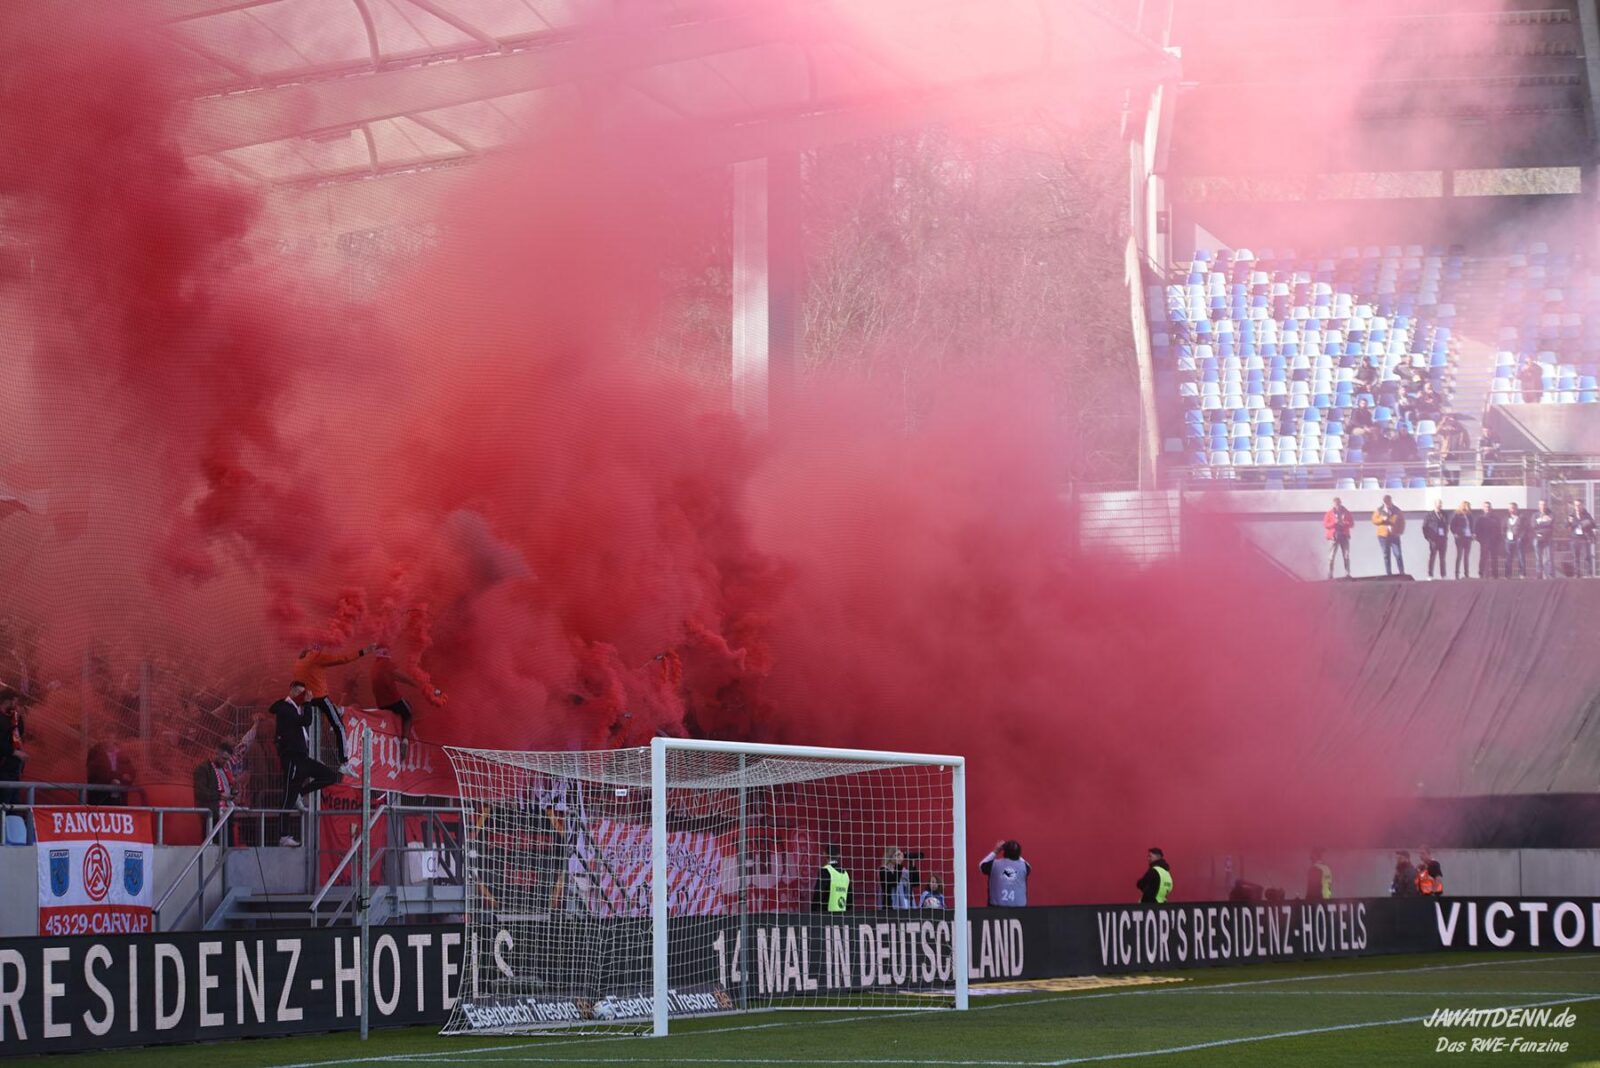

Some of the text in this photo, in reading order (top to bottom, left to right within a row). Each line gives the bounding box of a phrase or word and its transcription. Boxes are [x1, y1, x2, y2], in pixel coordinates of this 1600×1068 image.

[52, 812, 134, 834] FANCLUB
[1001, 889, 1015, 901] 24
[45, 912, 149, 936] 45329-CARNAP
[1097, 902, 1367, 966] VICTOR'S RESIDENZ-HOTELS
[757, 925, 818, 994] MAL
[825, 924, 851, 989] IN
[859, 918, 1024, 987] DEUTSCLAND
